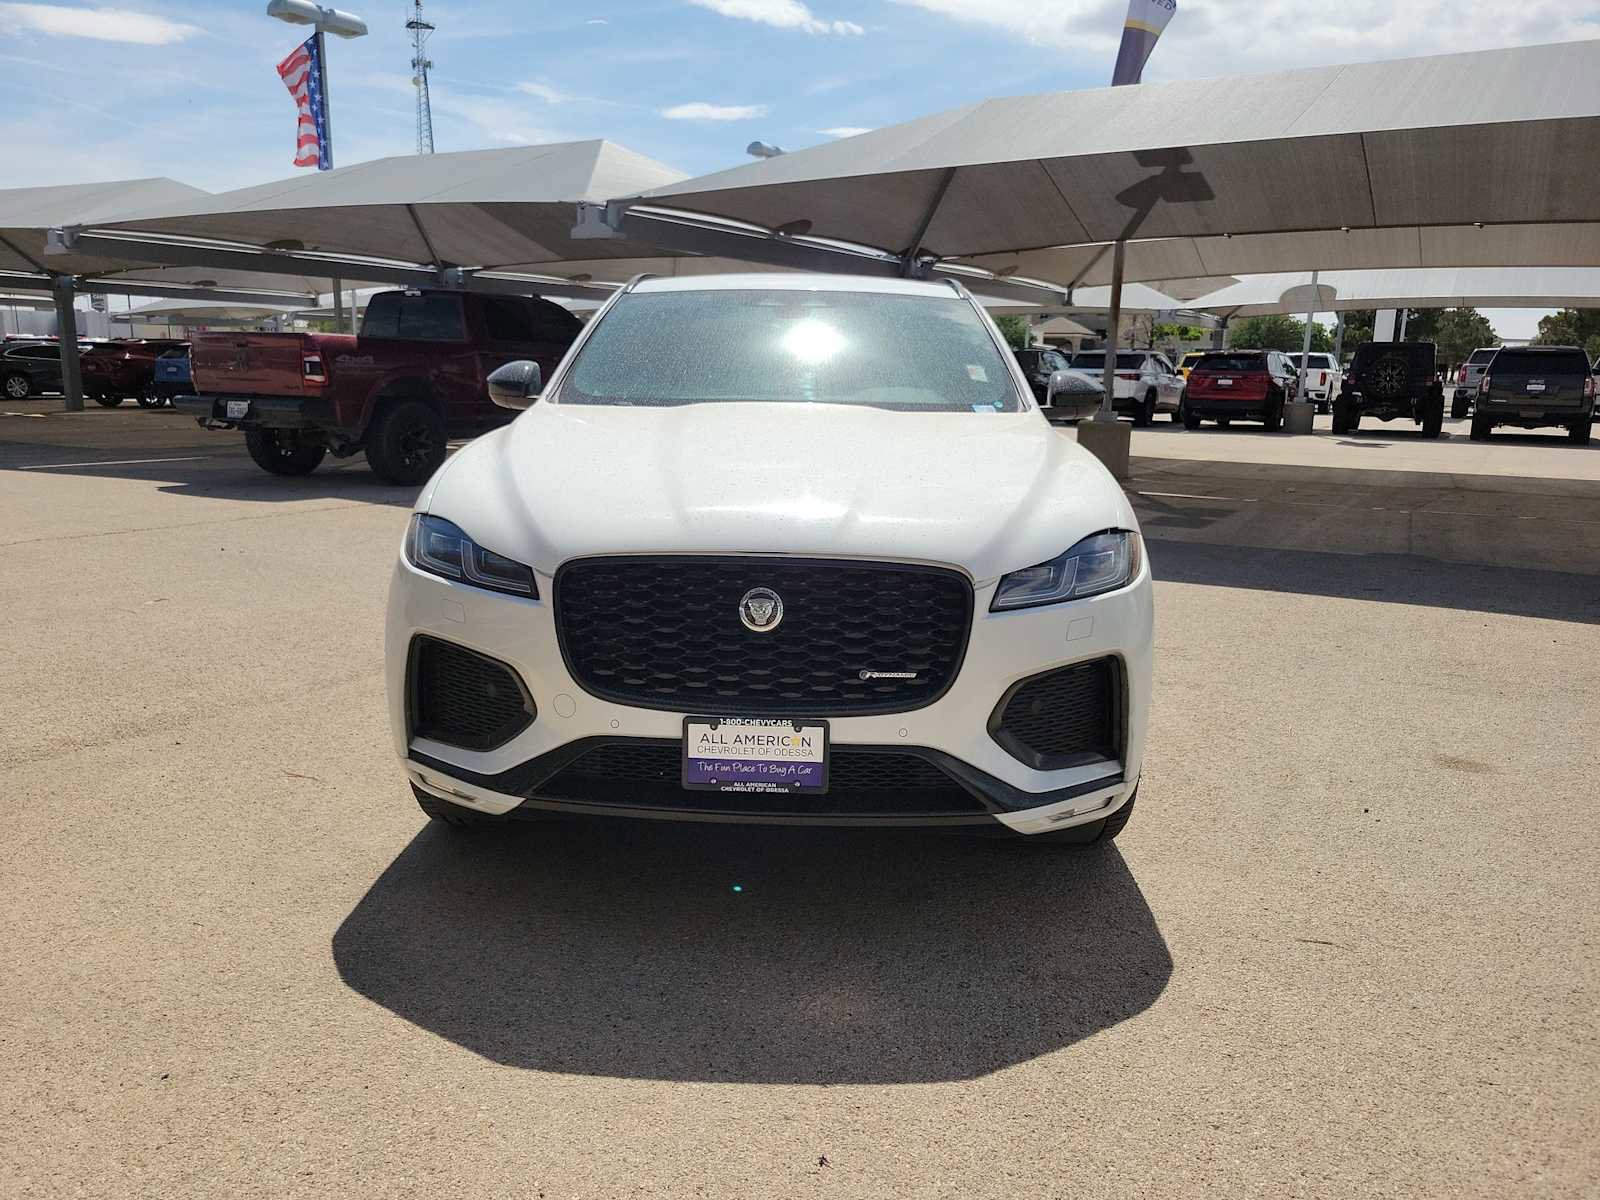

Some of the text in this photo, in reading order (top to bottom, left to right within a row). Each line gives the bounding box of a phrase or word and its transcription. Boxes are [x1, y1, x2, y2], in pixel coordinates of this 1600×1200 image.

[719, 718, 793, 727] 1-800-CHEVYCARS
[700, 733, 812, 748] ALL AMERICN
[697, 745, 814, 757] CHEVROLET OF ODESSA
[697, 761, 813, 777] The Fun Place To Buy A Car
